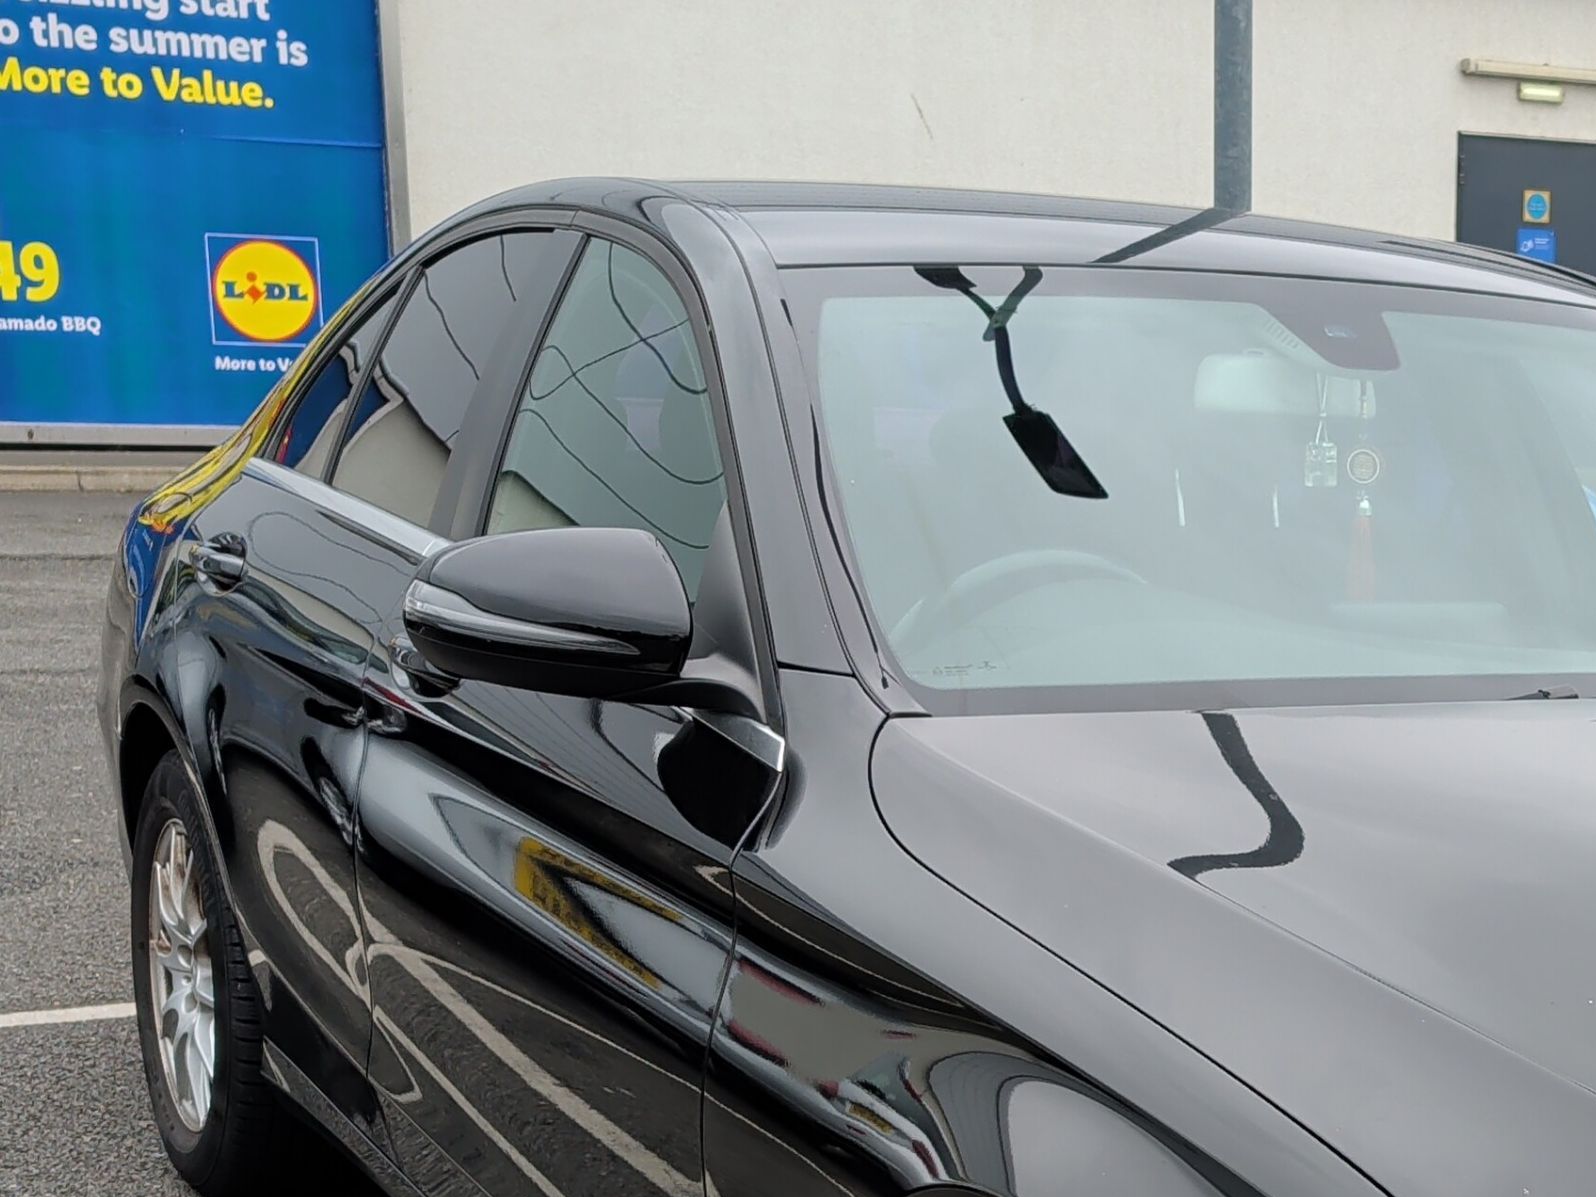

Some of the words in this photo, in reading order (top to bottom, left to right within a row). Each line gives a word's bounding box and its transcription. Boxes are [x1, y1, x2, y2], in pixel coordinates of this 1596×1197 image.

[29, 12, 98, 51] the
[108, 26, 267, 63] summer
[276, 29, 308, 66] is
[0, 56, 90, 96] More
[100, 66, 143, 99] to
[151, 66, 275, 108] Value.
[61, 315, 101, 336] BBQ
[215, 355, 256, 371] More
[259, 358, 276, 371] to
